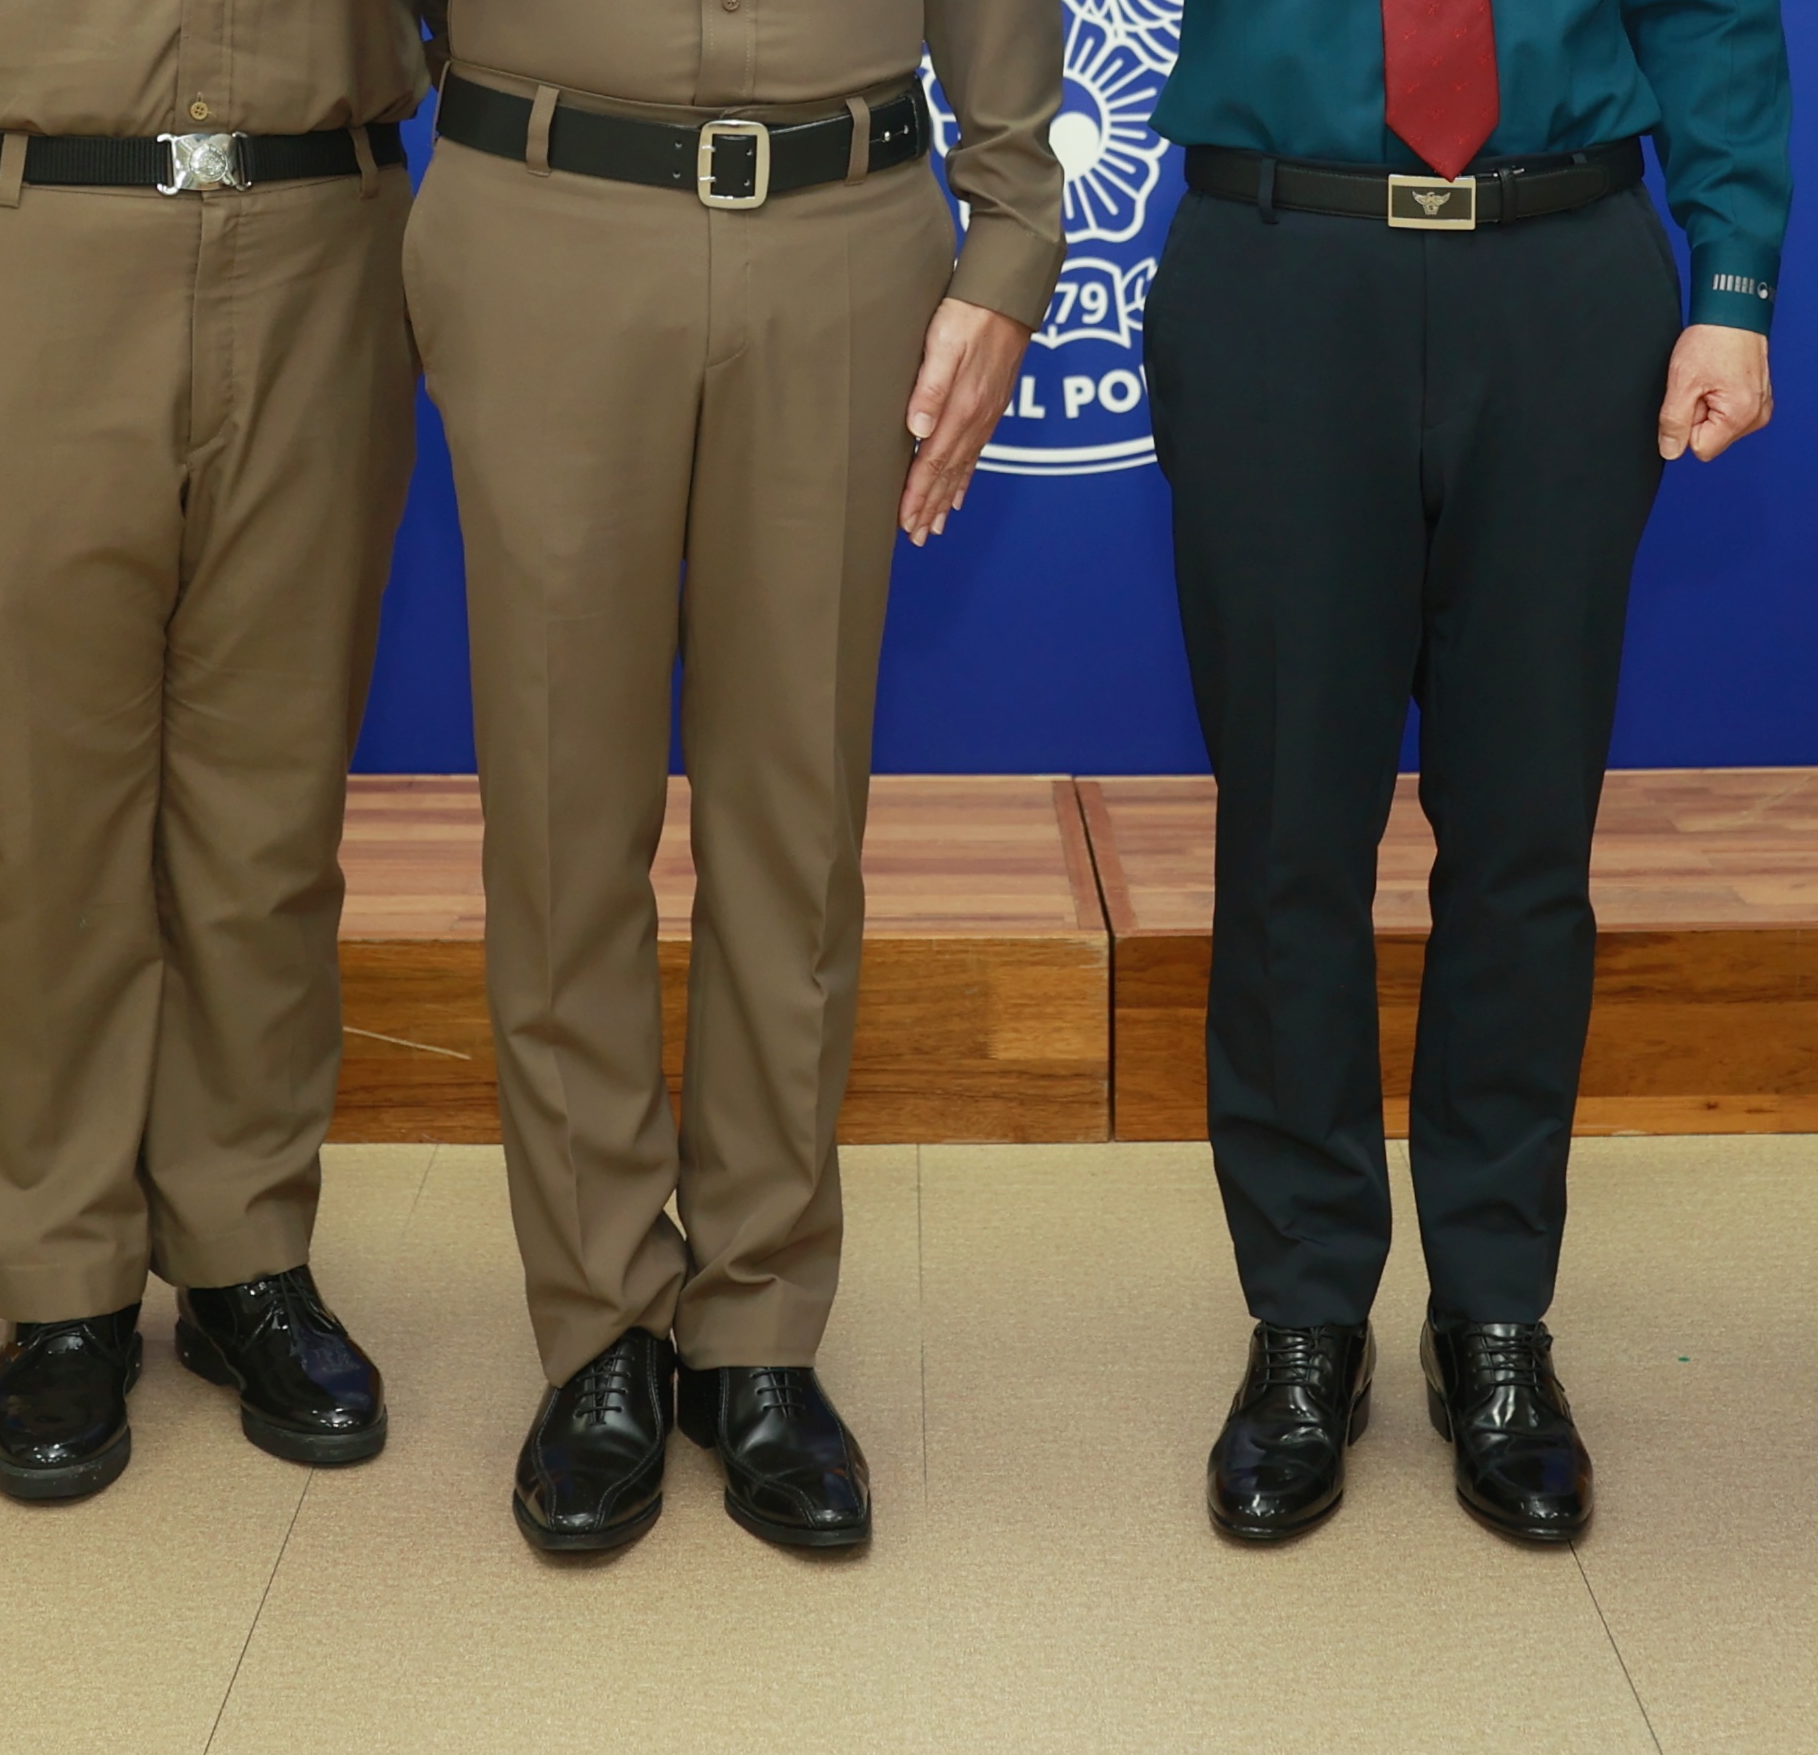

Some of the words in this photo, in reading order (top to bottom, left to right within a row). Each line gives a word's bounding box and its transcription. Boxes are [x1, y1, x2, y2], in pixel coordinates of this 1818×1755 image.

[1043, 282, 1108, 325] 79
[1003, 375, 1046, 419] L
[1063, 365, 1148, 419] PO
